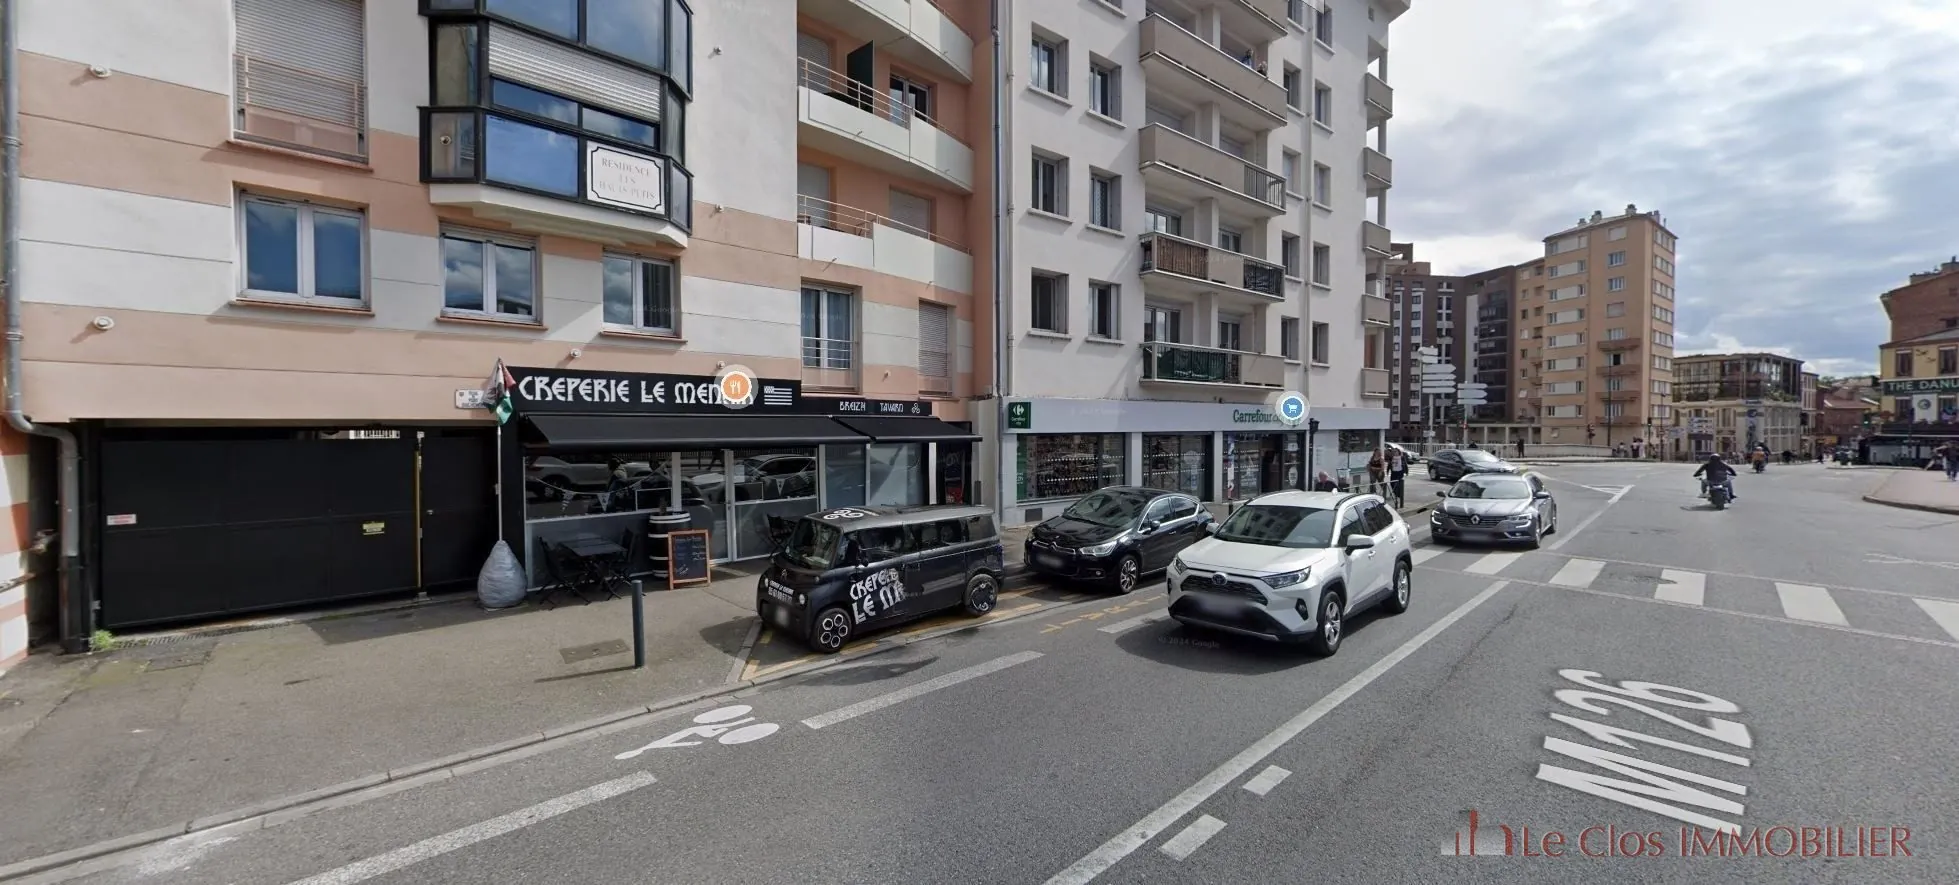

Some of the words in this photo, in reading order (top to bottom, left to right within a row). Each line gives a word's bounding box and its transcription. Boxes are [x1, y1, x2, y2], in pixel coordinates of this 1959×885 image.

[518, 375, 630, 402] CREPERIE
[640, 380, 665, 403] LE
[674, 380, 754, 405] MEN
[1888, 381, 1914, 392] THE
[1233, 408, 1272, 423] Carrefour
[852, 593, 876, 624] LE
[1536, 669, 1752, 837] M126
